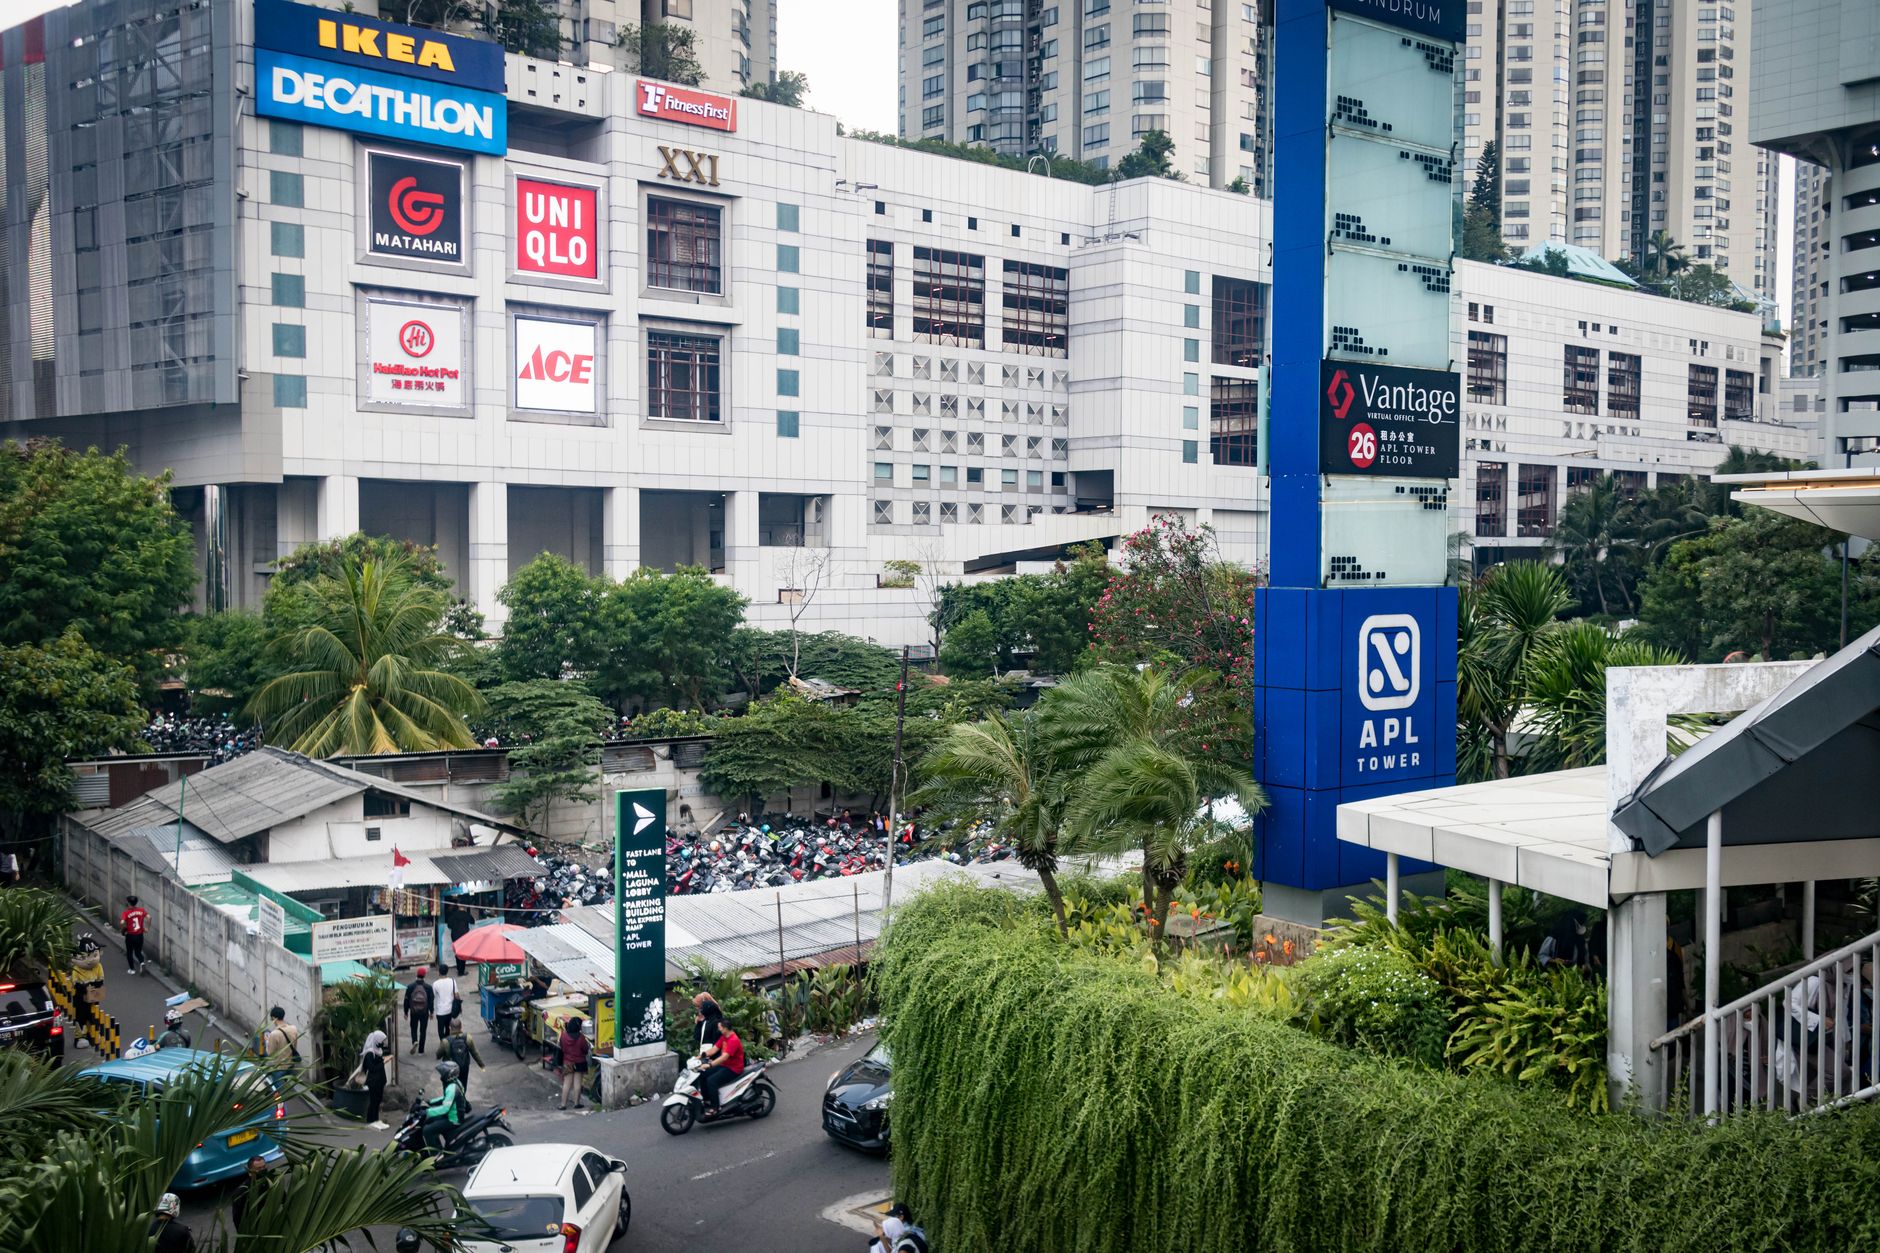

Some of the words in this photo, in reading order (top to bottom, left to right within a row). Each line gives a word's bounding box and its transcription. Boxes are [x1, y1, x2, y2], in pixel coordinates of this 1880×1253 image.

[318, 18, 456, 72] IKEA
[272, 66, 493, 139] DECATHLON
[657, 145, 720, 186] XXI
[525, 191, 582, 230] UNI
[375, 232, 457, 255] MATAHARI
[525, 230, 588, 267] QLO
[407, 327, 426, 348] Hi
[518, 343, 594, 384] ACE
[419, 366, 440, 378] Hot
[440, 367, 459, 380] Pot
[1360, 374, 1455, 424] Vantage
[1367, 412, 1392, 421] VIRTUAL
[1394, 414, 1415, 422] OFFICE
[1380, 430, 1415, 443] 租办公室
[1351, 431, 1375, 460] 26
[1380, 444, 1398, 453] APL
[1403, 445, 1436, 455] TOWER
[1380, 455, 1413, 465] FLOOR
[1359, 716, 1419, 749] APL
[1357, 752, 1420, 772] TOWER
[626, 850, 642, 858] FAST
[643, 848, 662, 857] LANE
[626, 859, 637, 867] TO
[626, 870, 648, 880] MALL
[626, 878, 659, 889] LAGUNA
[626, 887, 652, 898] LOBBY
[626, 899, 661, 910] PARKING
[625, 907, 664, 918] BUILDING
[637, 915, 663, 924] EXPRESS
[332, 921, 374, 932] PENGUMUMAN
[626, 924, 643, 932] RAMP
[626, 933, 640, 942] APL
[626, 940, 653, 951] TOWER
